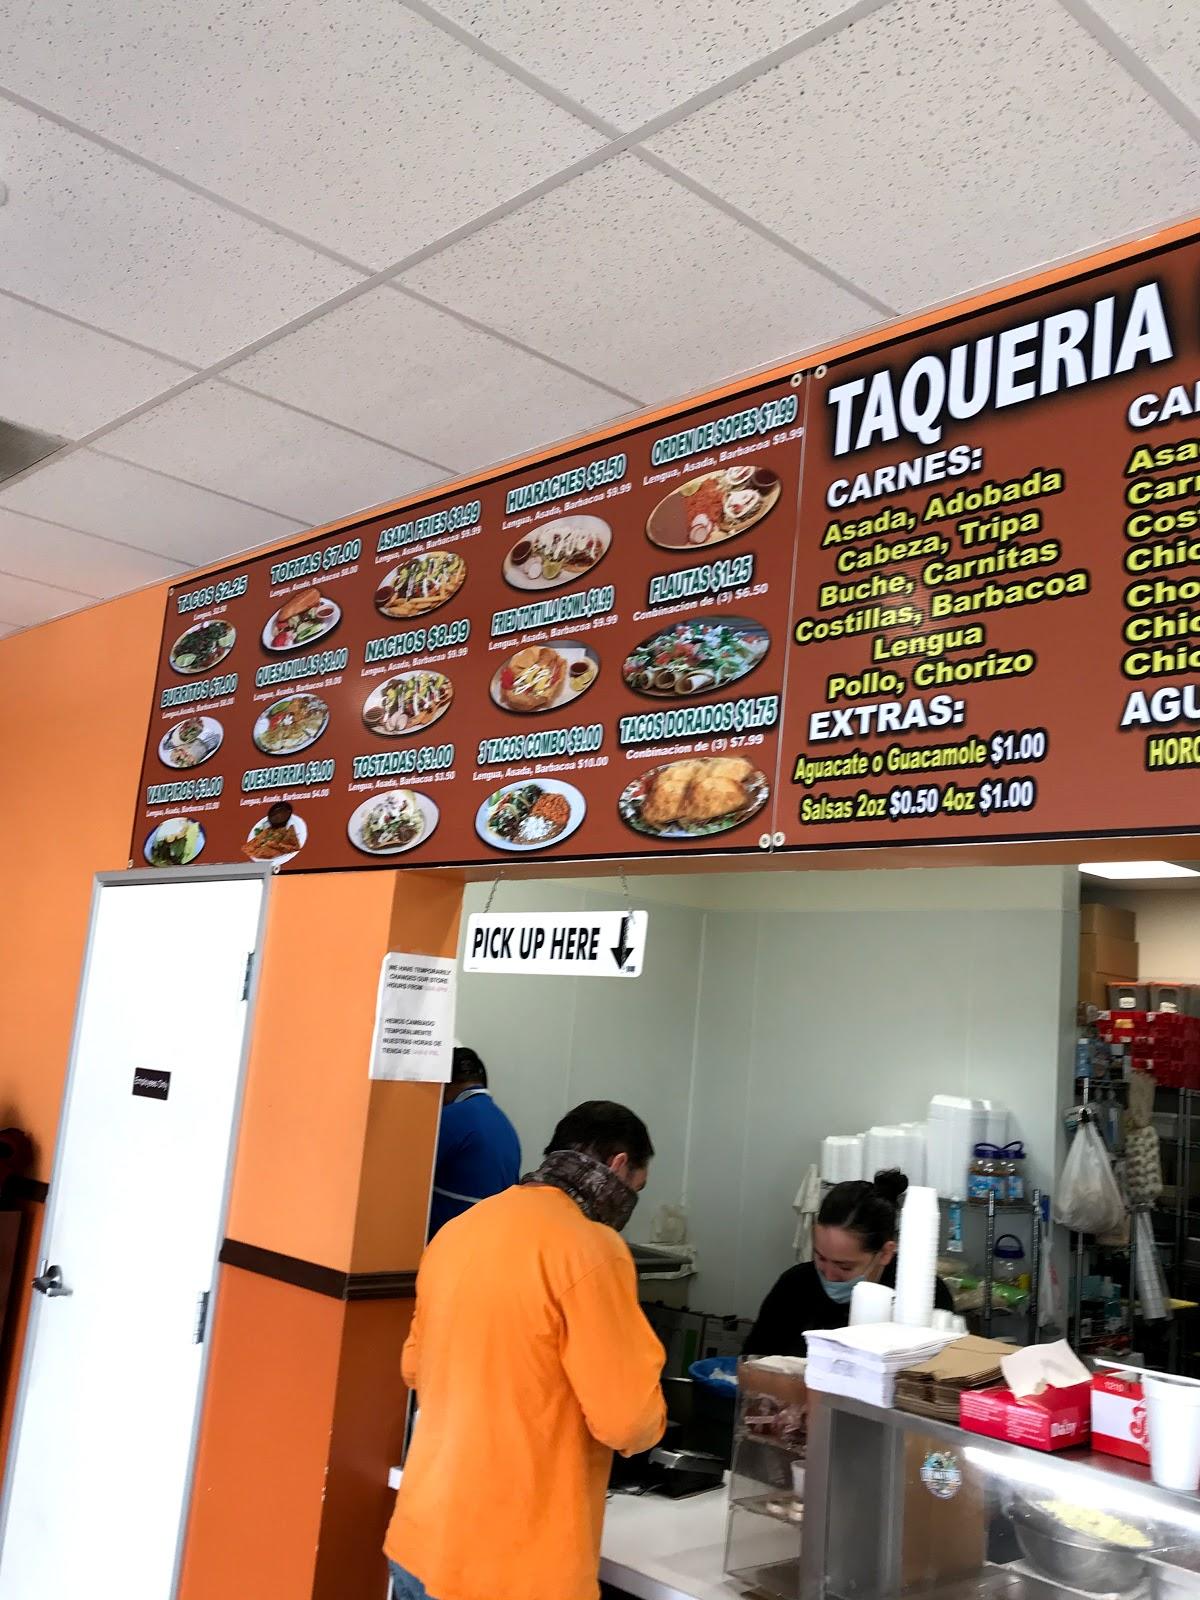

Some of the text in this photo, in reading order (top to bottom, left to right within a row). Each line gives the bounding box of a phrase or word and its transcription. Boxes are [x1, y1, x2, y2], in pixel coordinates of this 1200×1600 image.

[827, 281, 1174, 457] TAQUERIA
[1127, 380, 1200, 428] CA
[651, 394, 799, 466] ORDEN DE SOPES $7.99
[642, 468, 681, 486] Lengua,
[683, 456, 718, 474] Asada,
[719, 439, 771, 462] Barbacoa
[826, 444, 984, 509] CARNES:
[1127, 442, 1200, 474] Asa
[506, 453, 627, 514] HUARACHES $5.50
[377, 500, 481, 553] ASADA FRIES $8.99
[502, 515, 533, 531] Lengua,
[534, 506, 563, 521] Asada,
[564, 492, 605, 512] Barbacoa
[822, 470, 1063, 546] Asada, Adobada
[270, 538, 362, 585] TORTAS $7.00
[426, 534, 460, 549] Barbacoa
[837, 511, 1040, 573] Cabeza, Tripa
[177, 575, 248, 613] TACOS $2.25
[649, 554, 753, 604] FLAUTAS $1.25
[820, 541, 1060, 608] Buche, Carnitas
[491, 607, 518, 637] FRIED
[517, 597, 560, 631] TORTILLA
[560, 590, 587, 621] BOWL
[632, 582, 769, 622] Combinacion de (3) $6.50
[795, 572, 1088, 642] Costillas, Barbacoa
[365, 618, 471, 663] NACHOS $8.99
[488, 640, 519, 652] Lengua,
[520, 631, 548, 645] Asada,
[550, 622, 592, 639] Barbacoa
[872, 625, 984, 661] Lengua
[255, 647, 349, 688] QUESADILLAS $8.00
[827, 652, 1035, 700] Pollo, Chorizo
[160, 673, 238, 709] BURRITOS $7.00
[620, 695, 779, 744] TACOS DORADOS $1.75
[808, 694, 966, 742] EXTRAS:
[353, 744, 455, 779] TOSTADAS $3.00
[477, 723, 603, 765] 3 TACOS COMBO $9.00
[625, 733, 765, 760] Combinacion de (3) $7.99
[793, 732, 1046, 786] Aguacate o Guacamole $1.00
[147, 776, 224, 804] VAMPIROS $3.00
[241, 759, 336, 793] QUESABIRRIA $3.00
[348, 782, 374, 793] Lengua,
[375, 779, 399, 788] Asada,
[399, 775, 434, 786] Barbacoa
[472, 756, 609, 782] Lengua, Asada, Barbacoa $10.00
[800, 781, 1035, 822] Salsas 2oz $0.50 4oz $1.00
[472, 927, 601, 960] PICK UP HERE
